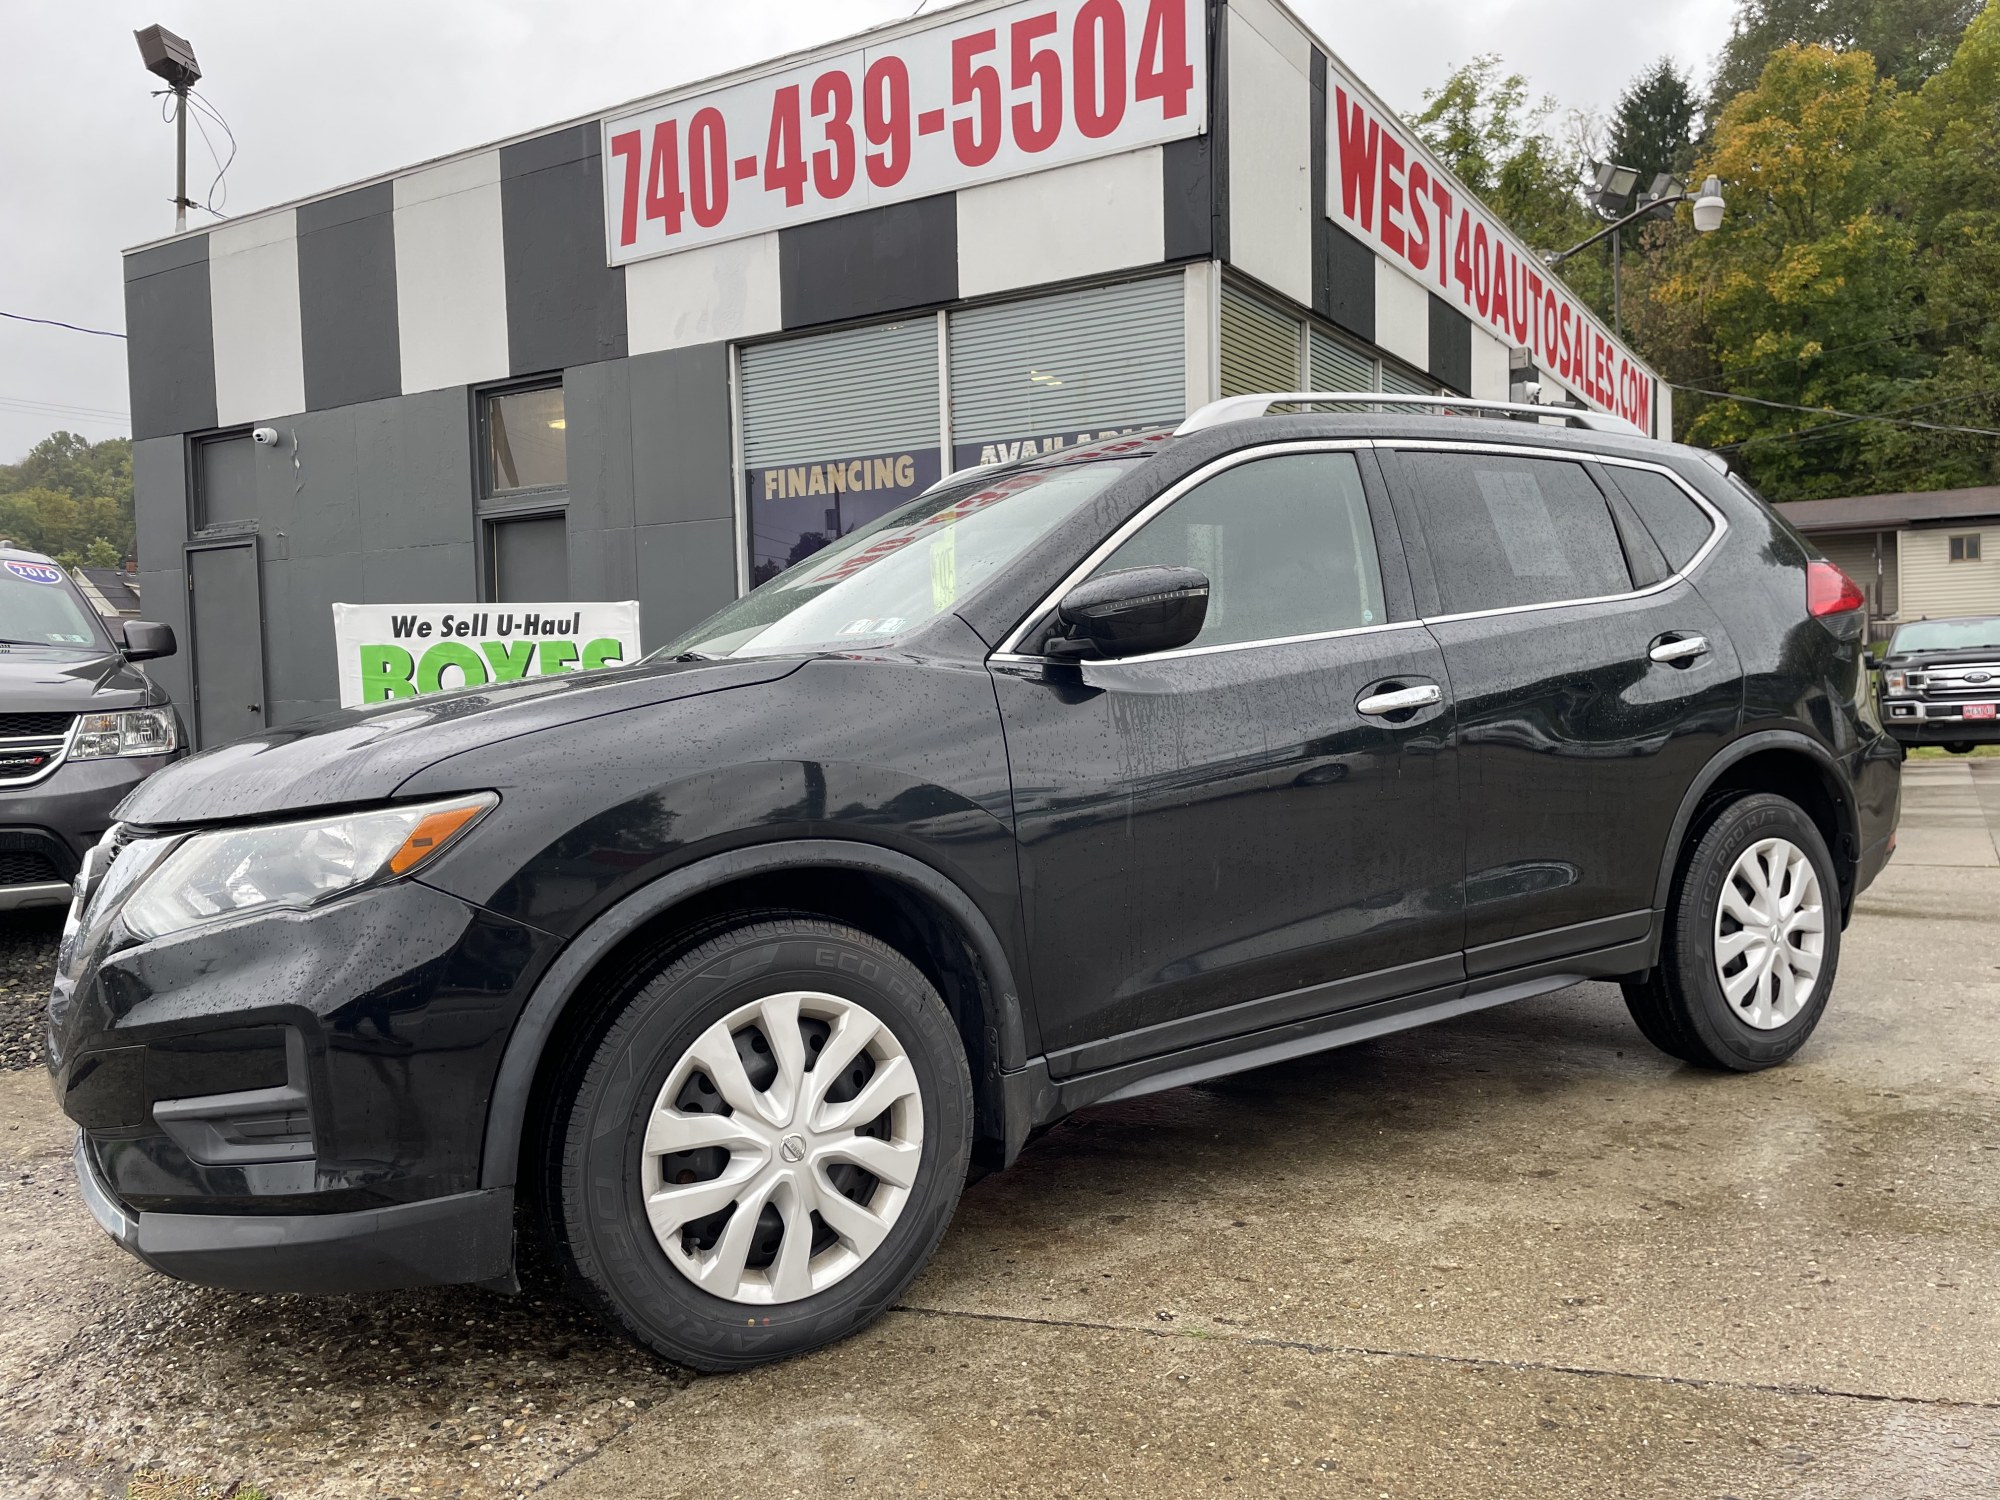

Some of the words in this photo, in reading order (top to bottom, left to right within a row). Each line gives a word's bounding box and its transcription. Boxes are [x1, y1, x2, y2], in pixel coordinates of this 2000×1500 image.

[611, 0, 1194, 247] 740-439-5504
[764, 454, 915, 500] FINANCING
[14, 566, 56, 580] 2016
[391, 614, 432, 638] We
[440, 613, 489, 637] Sell
[496, 612, 582, 636] U-Haul
[1701, 872, 1719, 919] ECO
[1716, 826, 1745, 866] PRO
[815, 946, 880, 982] ECO
[887, 977, 939, 1039] PRO
